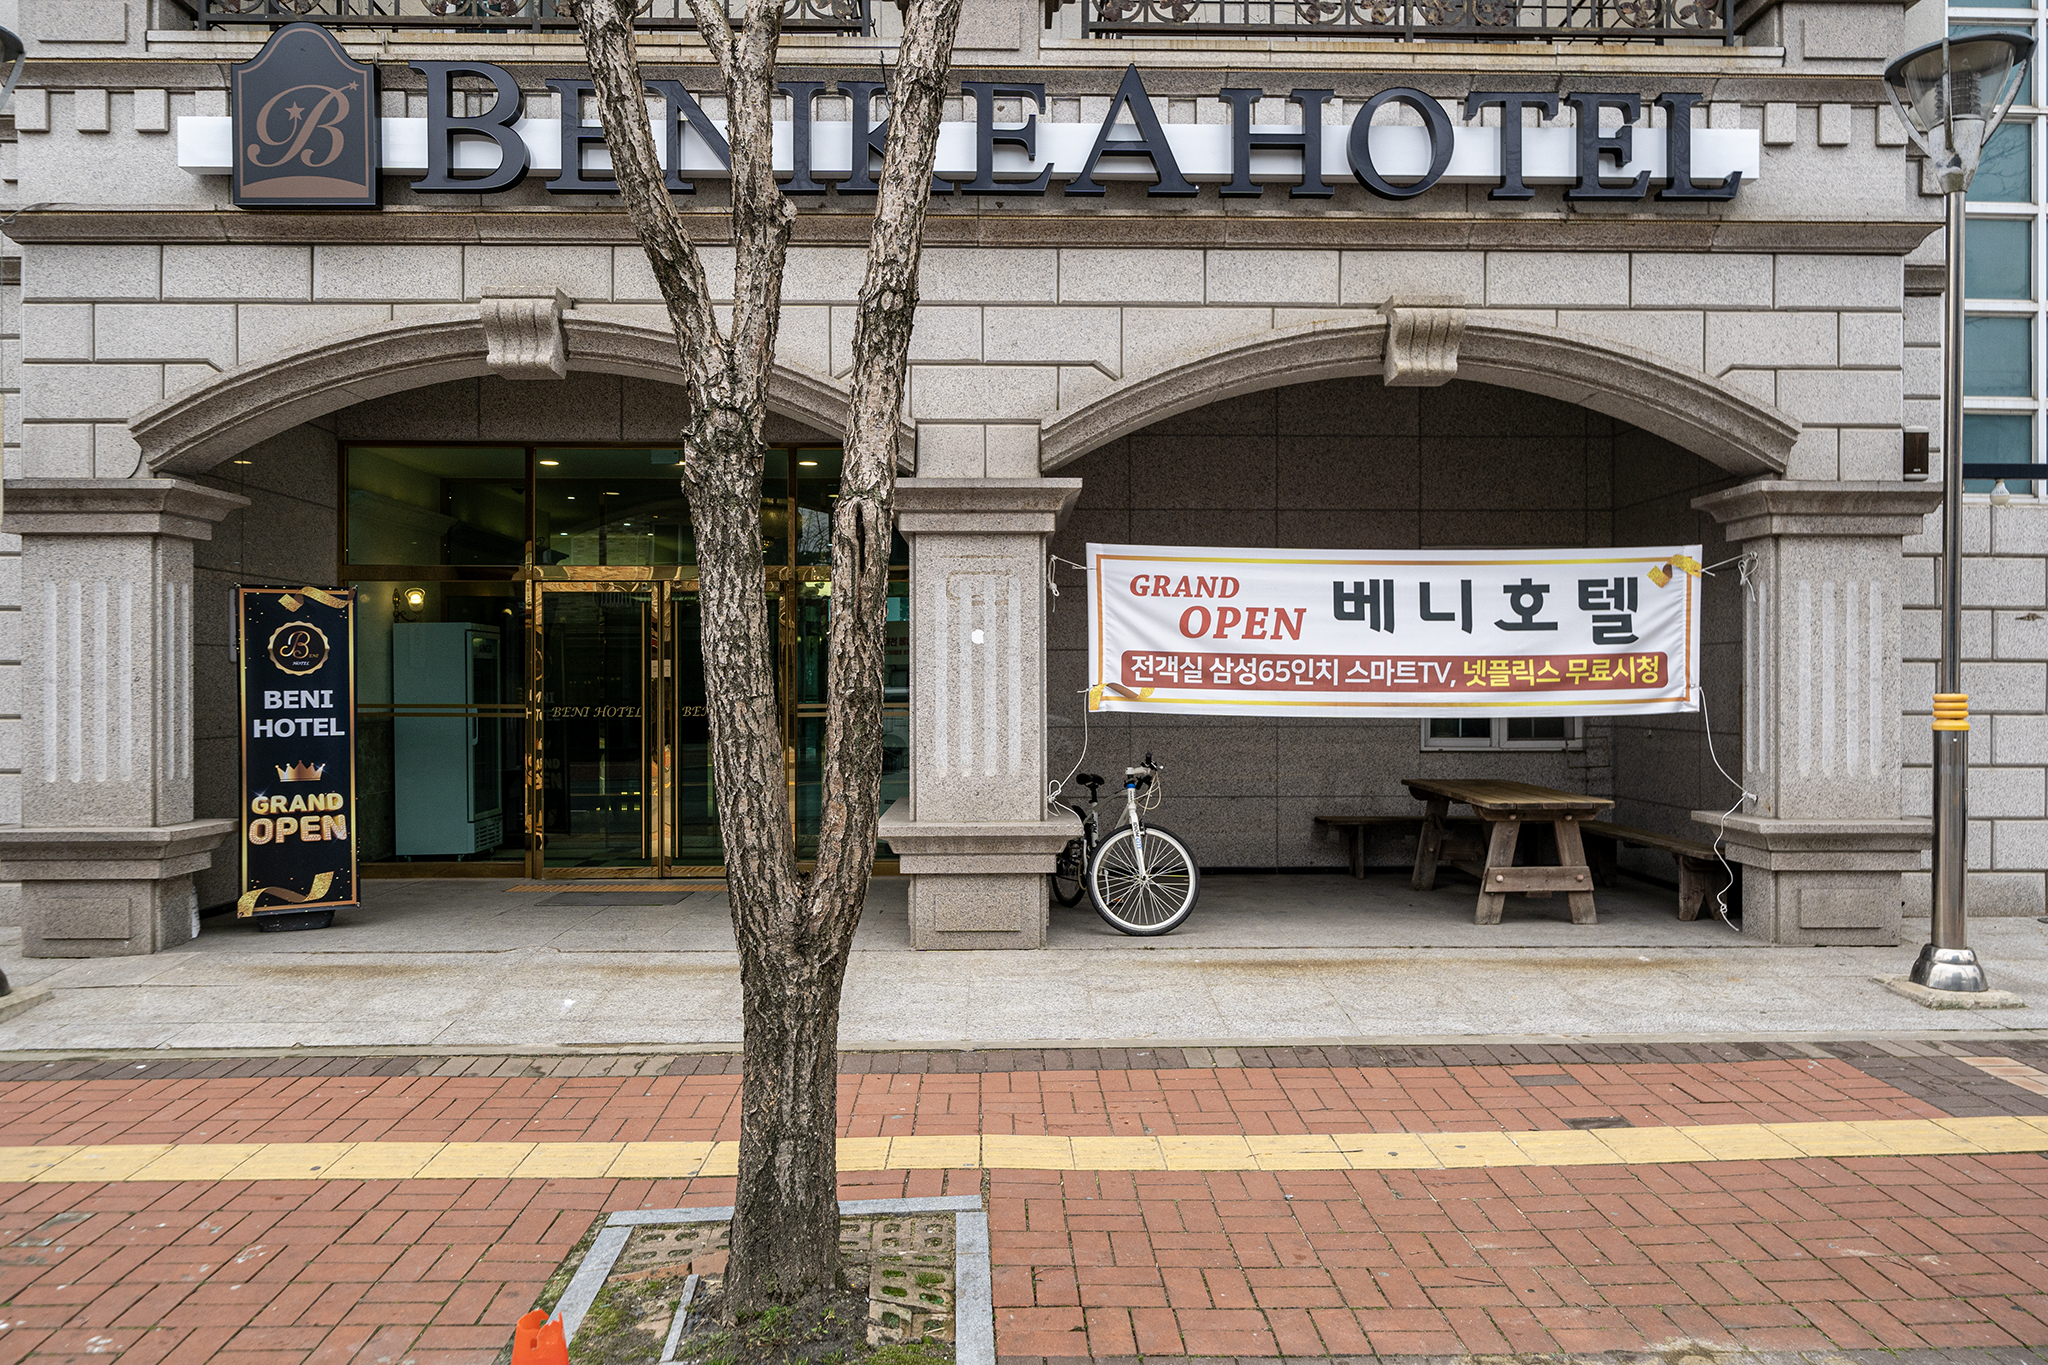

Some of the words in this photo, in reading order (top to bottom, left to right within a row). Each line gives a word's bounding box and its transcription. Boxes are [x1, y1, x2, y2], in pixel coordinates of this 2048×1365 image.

[1218, 85, 1744, 202] HOTEL
[1129, 574, 1240, 598] GRAND
[1178, 605, 1307, 640] OPEN
[1332, 576, 1640, 646] 베니호텔
[1130, 654, 1204, 683] 전객실
[1208, 656, 1339, 686] 삼성65인치
[1344, 658, 1456, 688] 스마트TV,
[1463, 658, 1561, 687] 넷플릭스
[1565, 654, 1659, 685] 무료시청
[264, 690, 333, 709] BENI
[552, 706, 590, 718] BENI
[593, 705, 642, 718] HOTEL
[253, 717, 345, 738] HOTEL
[251, 792, 344, 816] GRAND
[248, 814, 348, 846] OPEN
